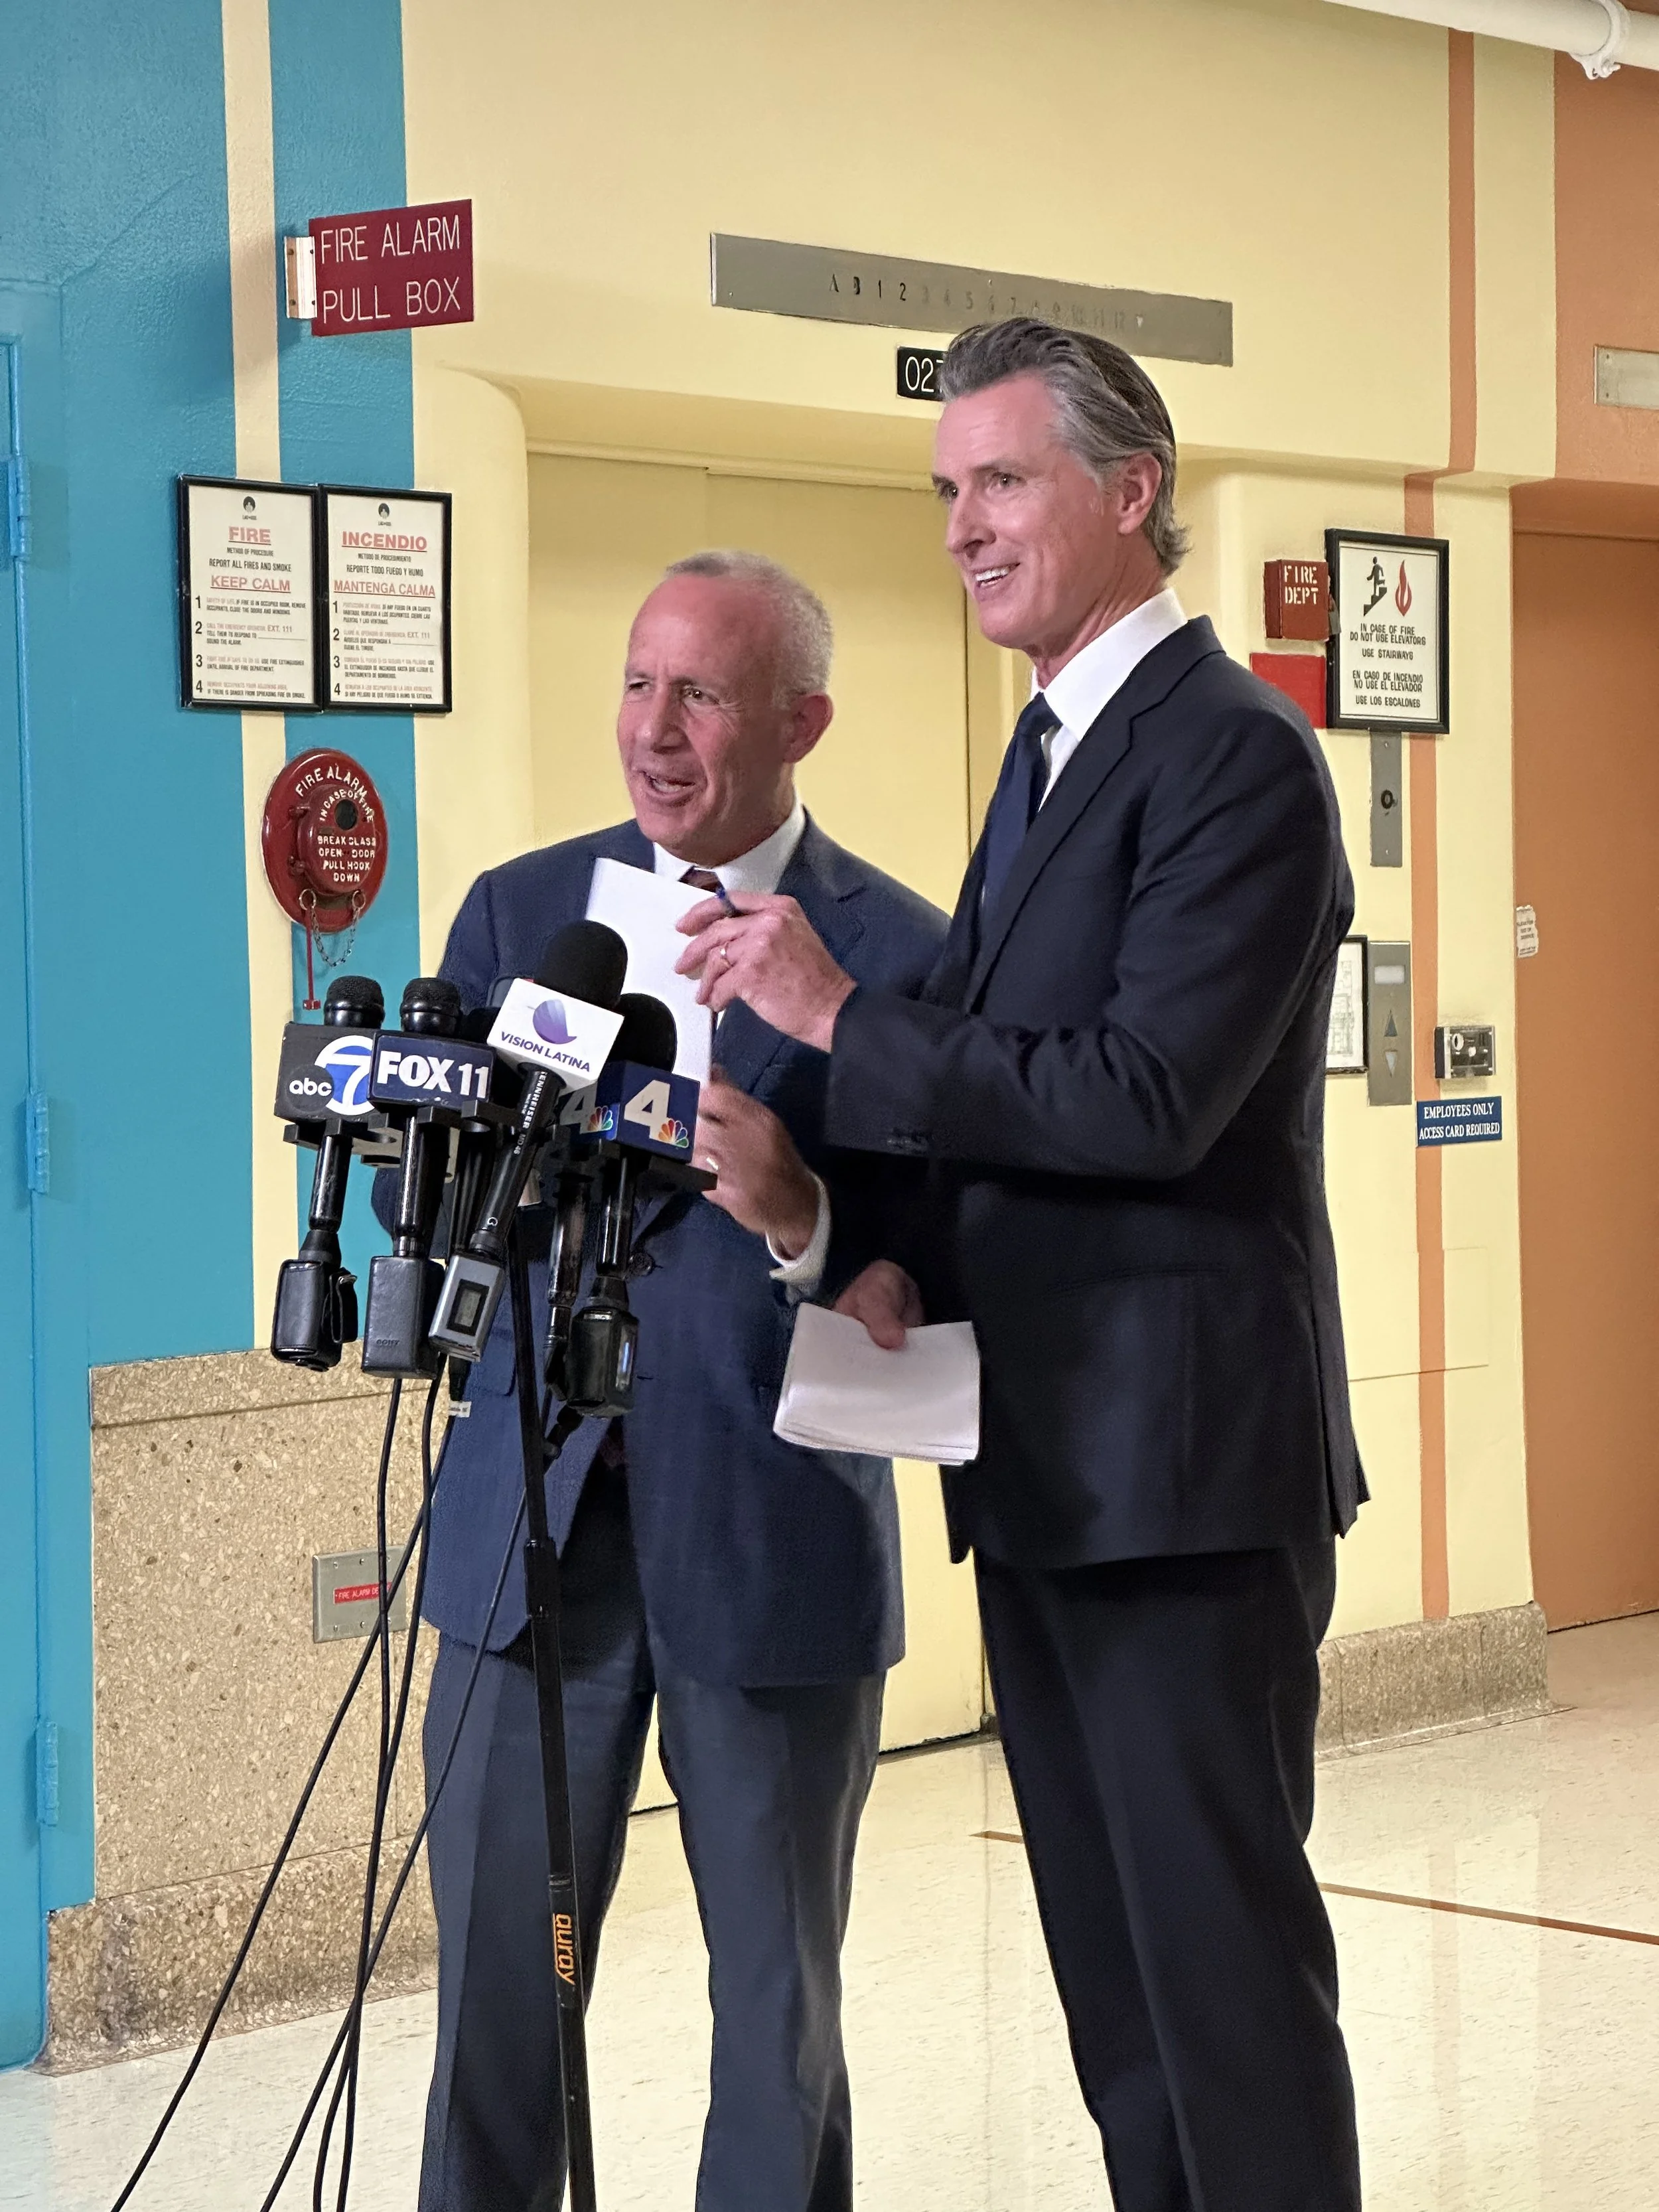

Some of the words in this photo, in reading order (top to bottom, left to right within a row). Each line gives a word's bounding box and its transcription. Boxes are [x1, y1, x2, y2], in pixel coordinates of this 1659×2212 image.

[321, 226, 368, 263] FIRE
[382, 215, 460, 258] ALARM
[900, 282, 906, 301] 2
[323, 285, 391, 324] PULL
[406, 277, 461, 315] BOX
[229, 526, 271, 542] FIRE
[342, 531, 427, 550] INCENDIO
[210, 558, 230, 567] REPORT
[244, 561, 259, 569] FIRES
[346, 565, 369, 573] REPORTE
[1285, 565, 1317, 584] FIRE
[211, 575, 247, 587] KEEP
[252, 577, 290, 591] CALM
[334, 580, 395, 594] MANTENGA
[399, 584, 435, 596] CALMA
[196, 595, 200, 608] 1
[1285, 586, 1319, 605] DEPT
[333, 601, 338, 613] 1
[195, 621, 202, 634] 2
[333, 628, 339, 640] 2
[1360, 623, 1367, 632] IN
[1370, 624, 1386, 633] CASE
[1389, 625, 1398, 634] OF
[1401, 626, 1415, 635] FIRE
[1350, 632, 1358, 640] DO
[1360, 632, 1373, 641] NOT
[1376, 634, 1388, 642] USE
[1391, 634, 1426, 645] ELEVATORS
[196, 654, 202, 667] 3
[1362, 648, 1374, 657] USE
[1378, 649, 1413, 660] STAIRWAYS
[334, 656, 340, 668] 3
[1364, 671, 1380, 680] CASO
[1383, 672, 1391, 681] DE
[1394, 672, 1423, 683] INCENDIO
[196, 680, 202, 693] 4
[334, 683, 340, 695] 4
[1354, 679, 1362, 689] NO
[1366, 680, 1378, 689] USE
[1381, 681, 1388, 690] EL
[1391, 682, 1422, 692] ELEVADOR
[1356, 696, 1368, 705] USE
[1370, 696, 1382, 705] LOS
[1385, 697, 1420, 707] ESCALONES
[295, 768, 323, 796] FIRE
[327, 765, 367, 798] ALARM
[320, 809, 327, 822] IN
[324, 789, 346, 808] CASE
[348, 790, 358, 800] OF
[318, 836, 346, 845] BREAK
[349, 837, 376, 846] GLASS
[319, 848, 342, 857] OPEN
[352, 849, 375, 858] DOOR
[323, 860, 344, 869] PULL
[347, 861, 370, 870] HOOK
[334, 873, 360, 881] DOWN
[501, 1031, 543, 1055] VISION
[544, 1048, 590, 1072] LATINA
[318, 1043, 374, 1112] 7
[377, 1050, 455, 1093] FOX
[458, 1063, 489, 1099] 11
[289, 1077, 332, 1096] abc
[559, 1082, 597, 1134] 4
[624, 1080, 671, 1143] 4
[1424, 1104, 1471, 1119] EMPLOYEES
[1473, 1102, 1494, 1115] ONLY
[1419, 1126, 1444, 1140] ACCESS
[1445, 1125, 1464, 1137] CARD
[1466, 1122, 1500, 1136] REQUIRED
[352, 1588, 370, 1599] ALARM
[552, 1913, 576, 1986] auray
